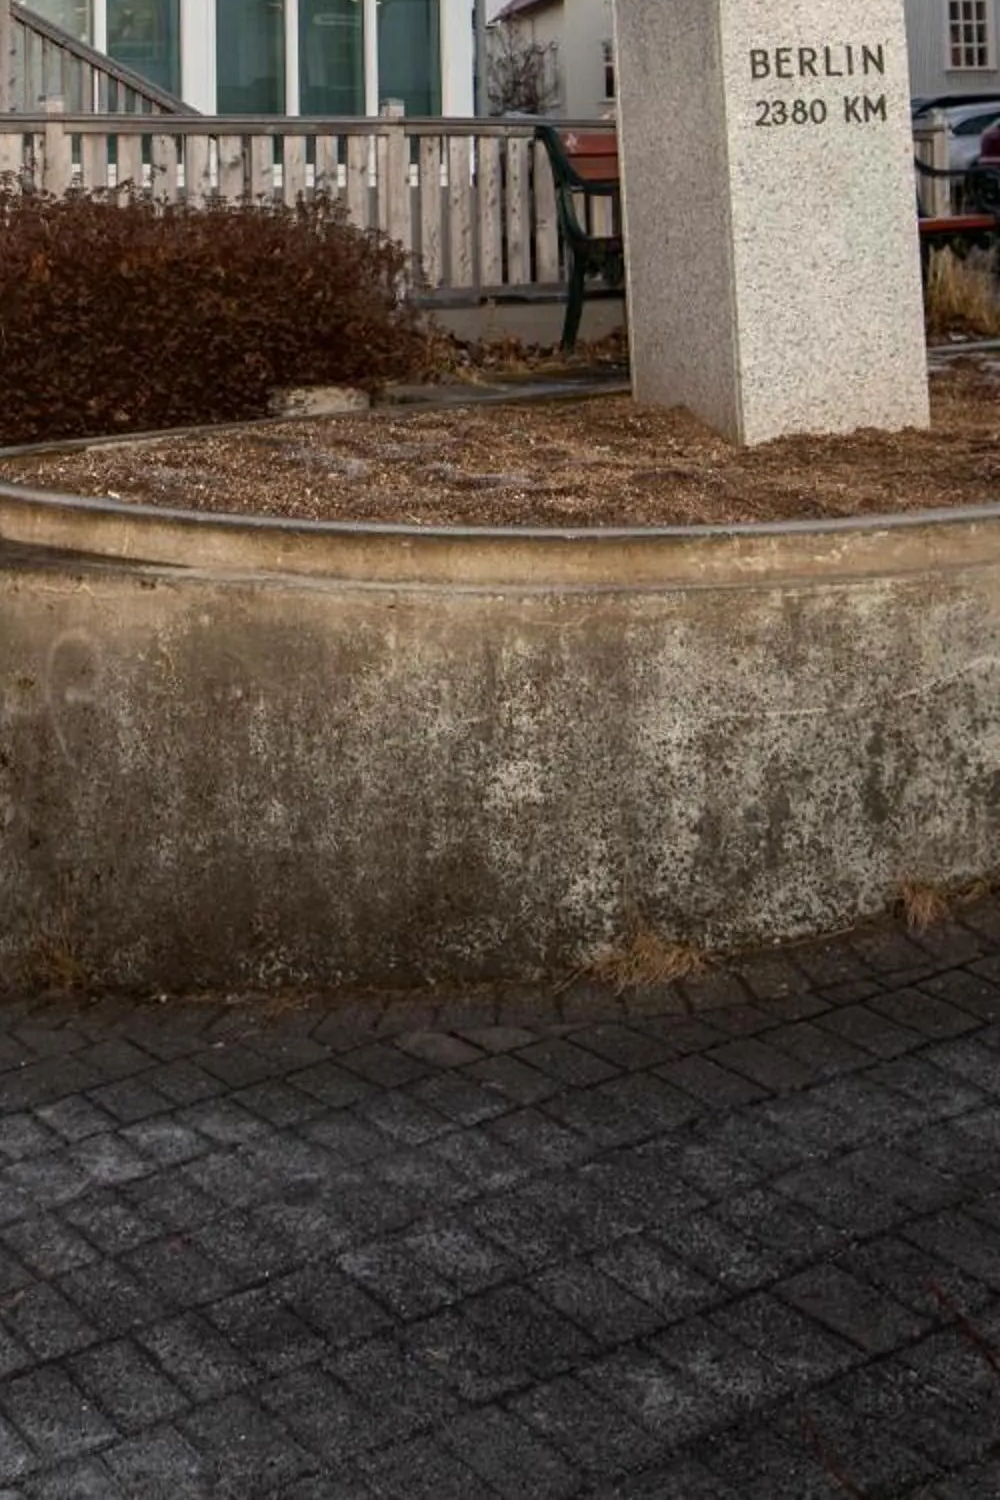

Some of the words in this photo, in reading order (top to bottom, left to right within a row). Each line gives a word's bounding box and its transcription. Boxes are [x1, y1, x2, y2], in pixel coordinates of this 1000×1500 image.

[750, 44, 885, 79] BERLIN
[755, 99, 827, 126] 2380
[843, 94, 888, 123] KM
